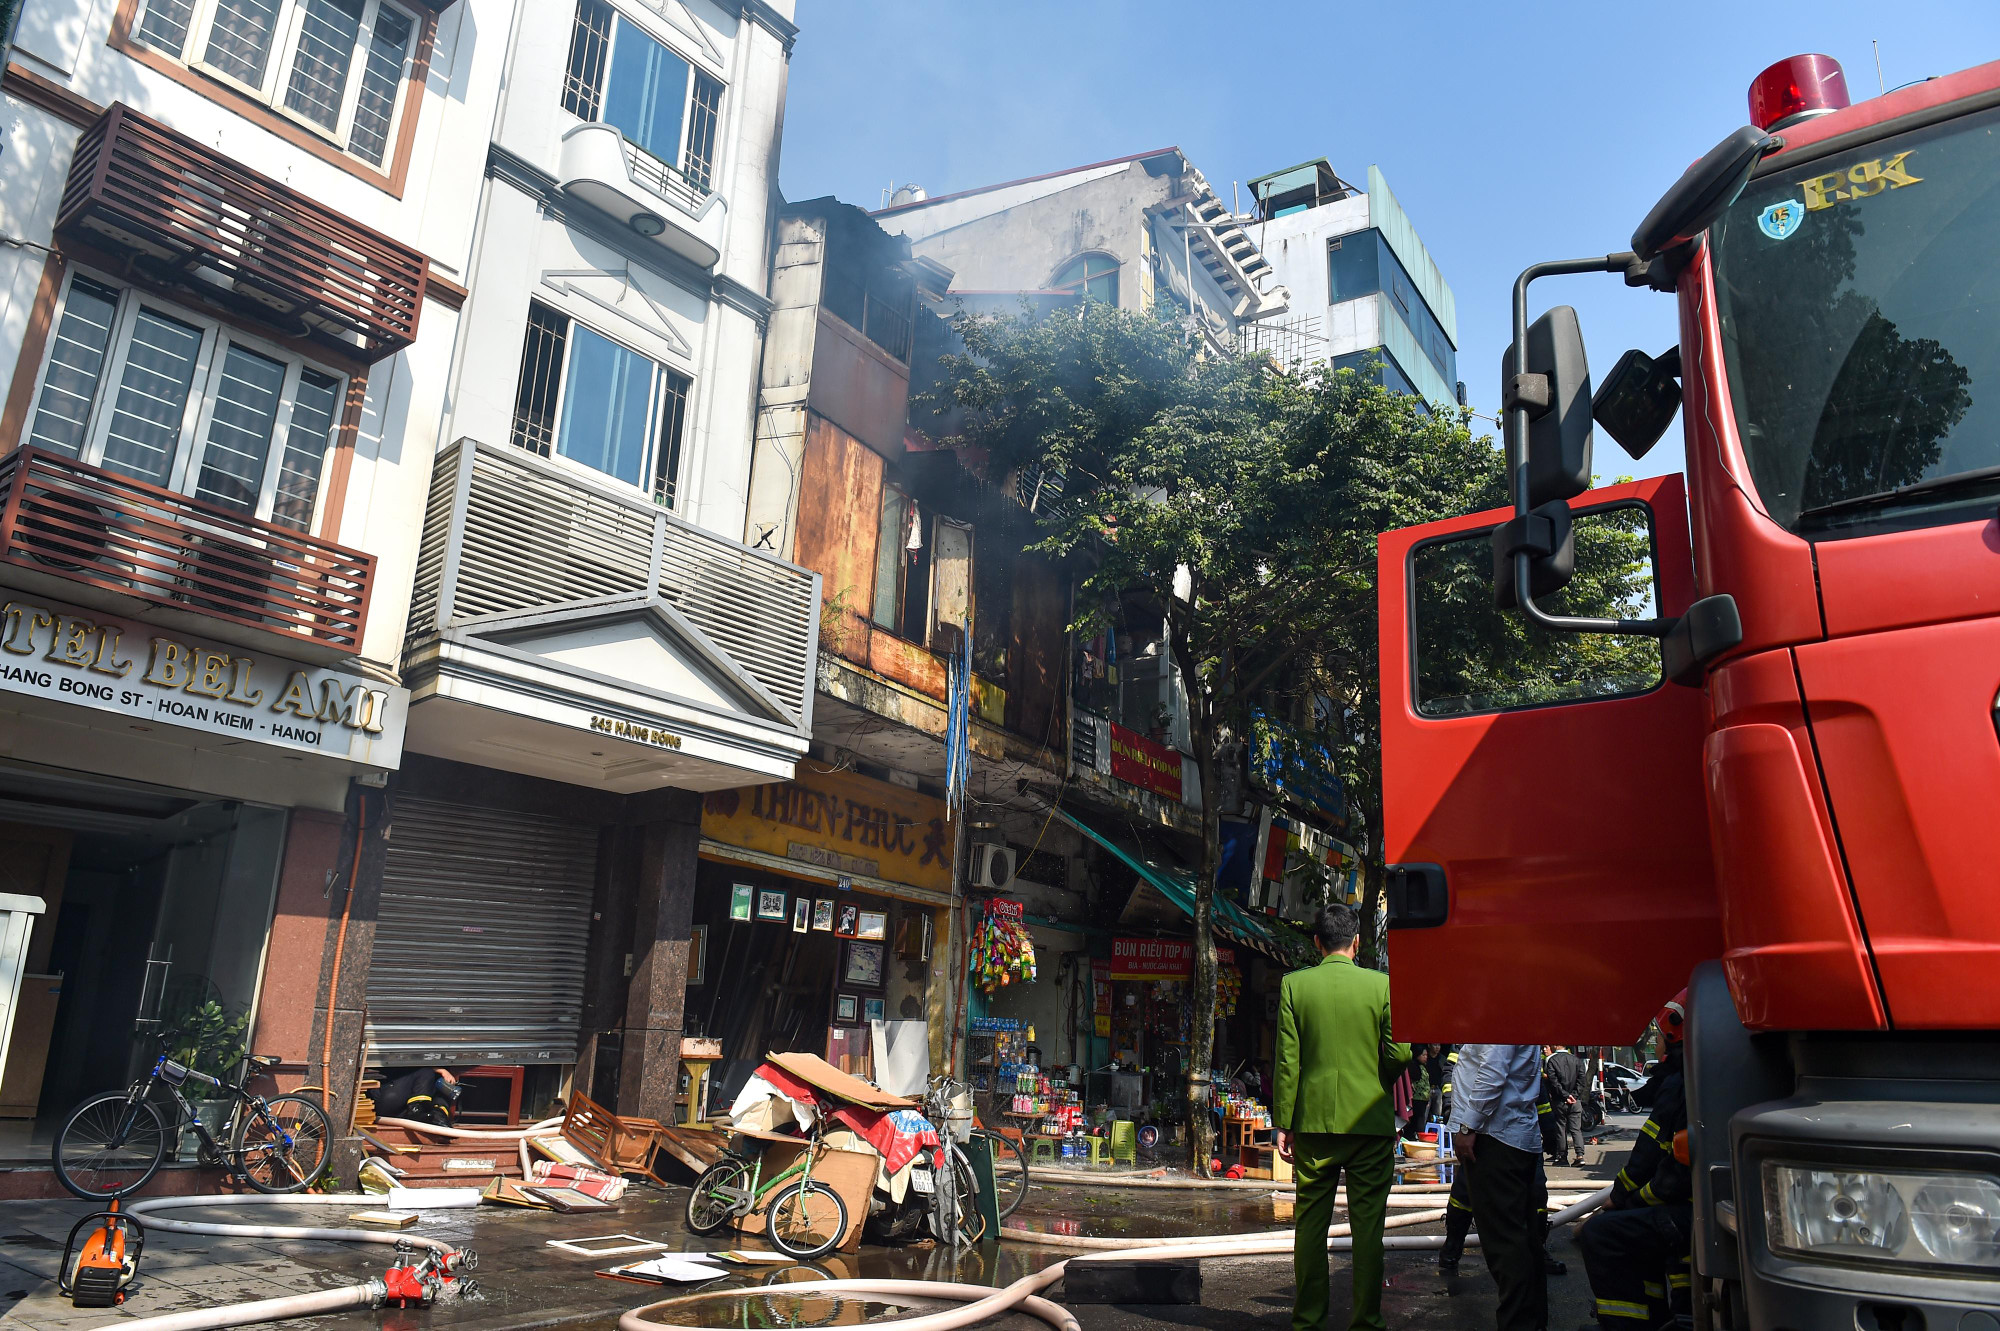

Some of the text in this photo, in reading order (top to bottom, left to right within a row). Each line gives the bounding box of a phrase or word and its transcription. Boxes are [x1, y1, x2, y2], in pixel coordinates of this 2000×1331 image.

[144, 637, 264, 707] BEL
[272, 671, 389, 733] AMI
[0, 664, 52, 688] HANG
[59, 677, 113, 701] BONG
[120, 691, 143, 707] ST
[158, 699, 209, 722] HOAN
[213, 711, 253, 730] KIEM
[271, 724, 321, 745] HANOI
[590, 715, 612, 733] 242
[839, 877, 850, 888] 240
[1114, 940, 1136, 957] BÚN
